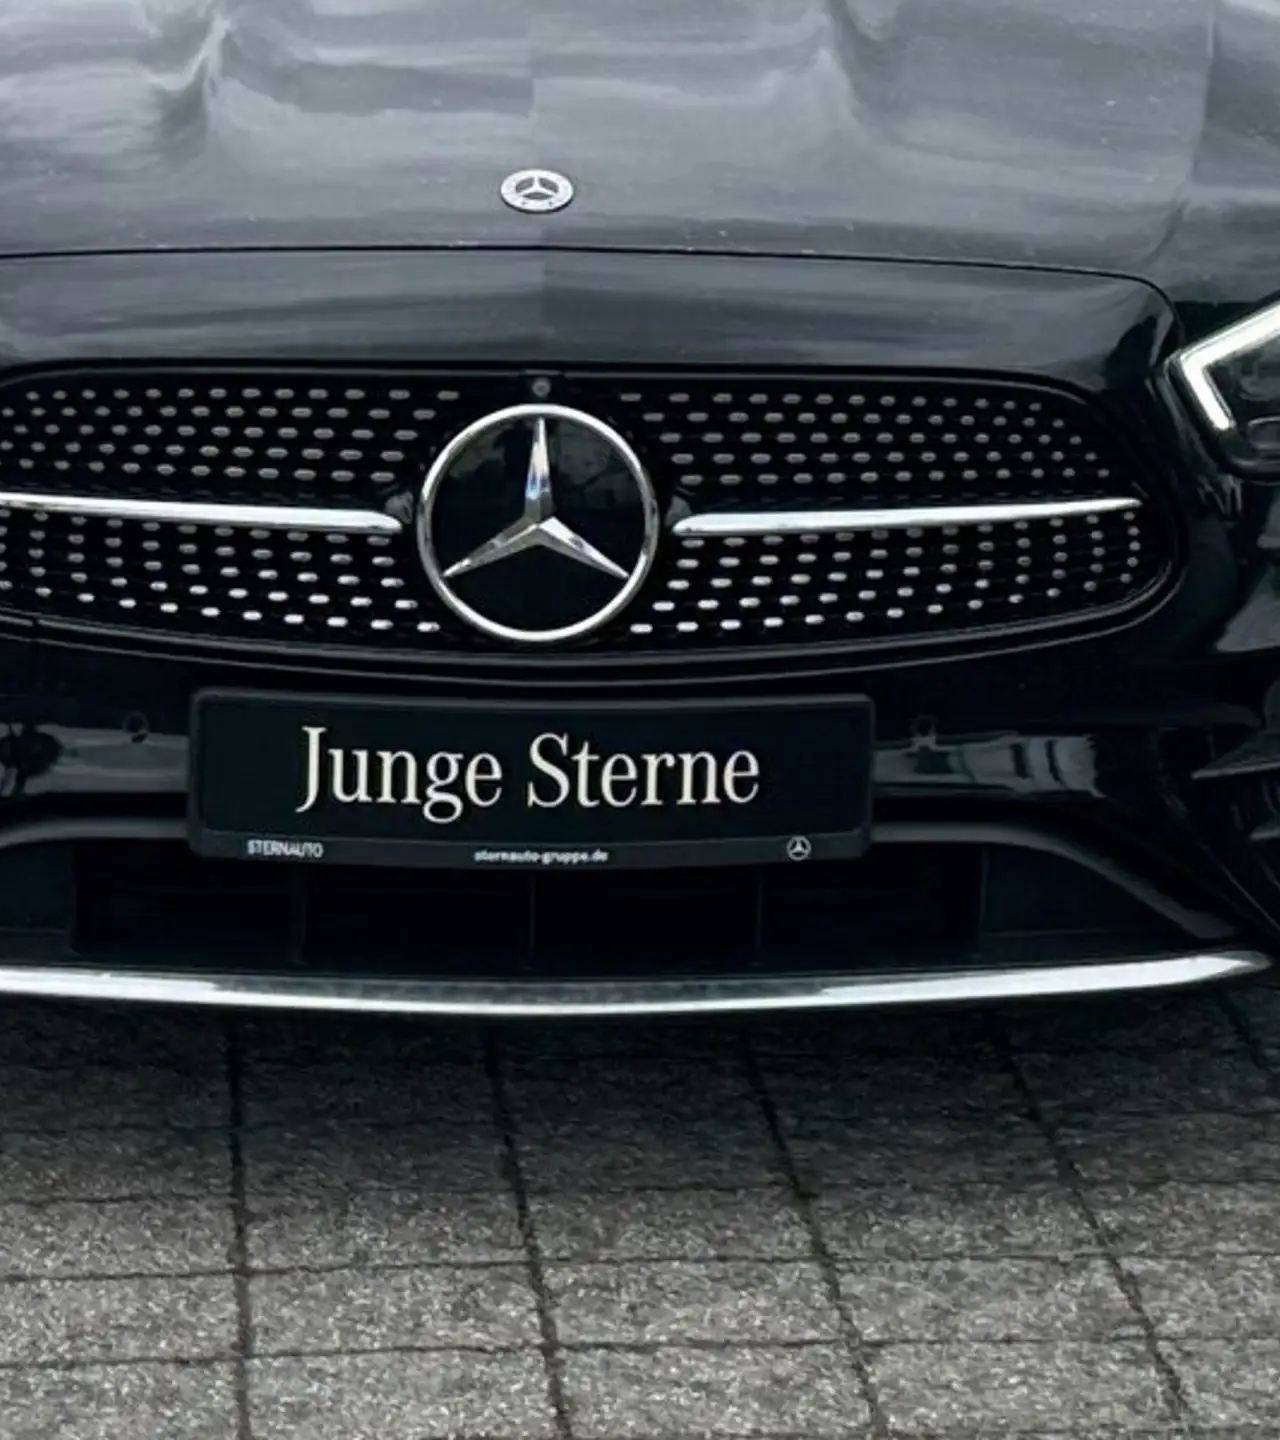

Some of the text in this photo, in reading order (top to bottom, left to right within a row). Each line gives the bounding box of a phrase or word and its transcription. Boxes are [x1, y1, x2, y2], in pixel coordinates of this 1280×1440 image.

[296, 726, 759, 823] Junge Sterne
[248, 840, 324, 858] STERNAUTO
[474, 850, 608, 865] sternauto-gruppe.de
